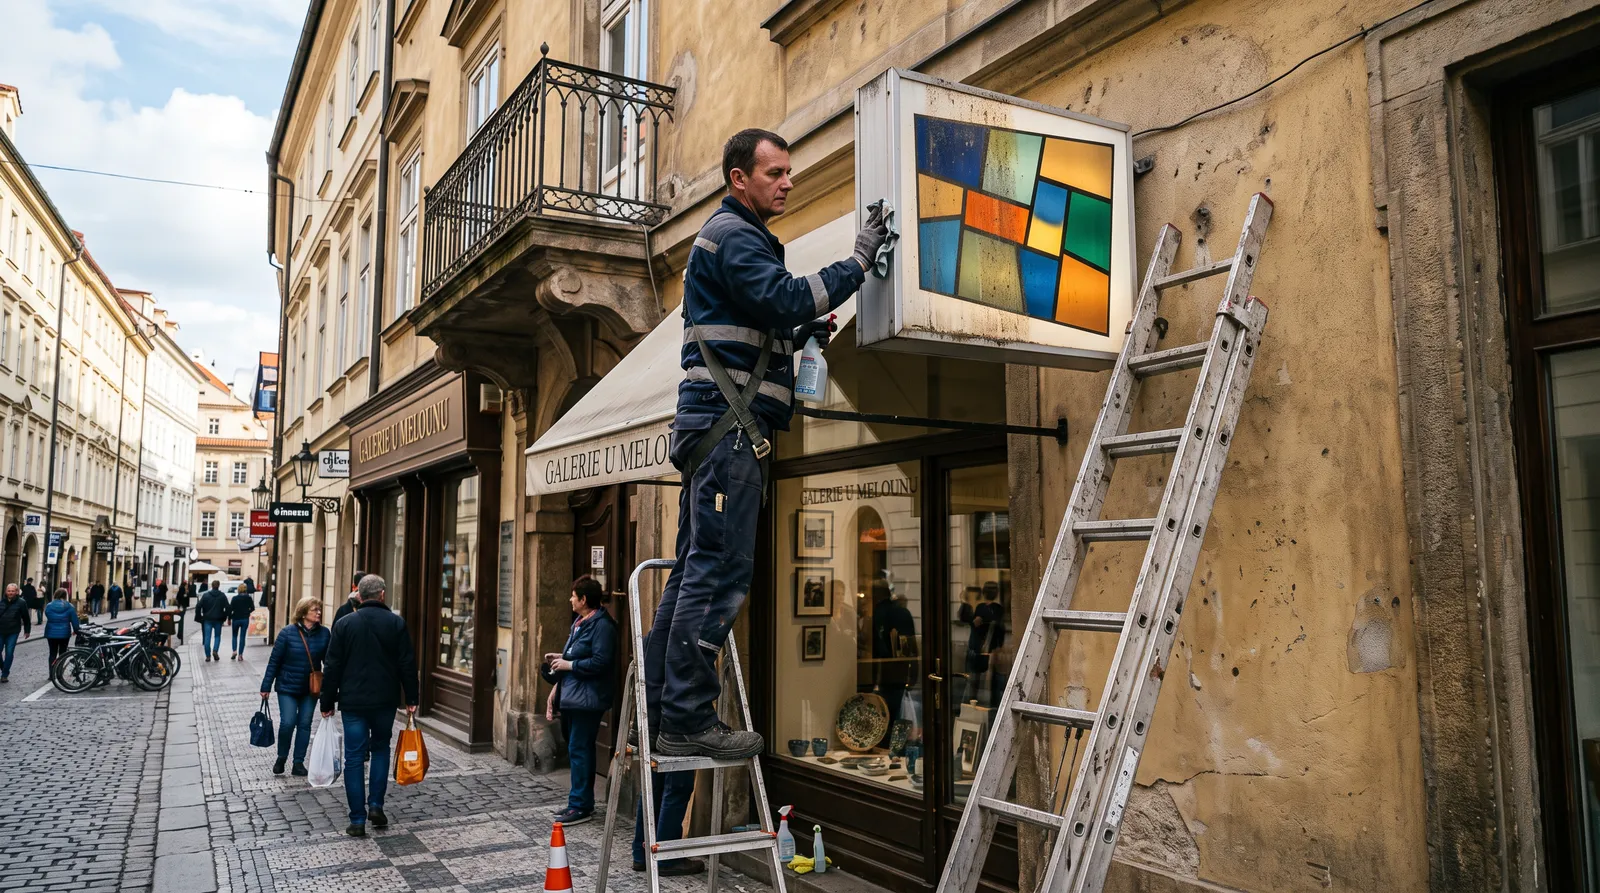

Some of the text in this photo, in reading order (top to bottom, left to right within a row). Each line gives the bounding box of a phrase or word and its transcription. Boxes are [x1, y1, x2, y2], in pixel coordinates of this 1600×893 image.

[360, 397, 450, 463] GALERIE U MELOUNU
[545, 449, 600, 485] GALERIE
[605, 446, 617, 474] U
[800, 476, 918, 505] GALERIE U MELOUNU
